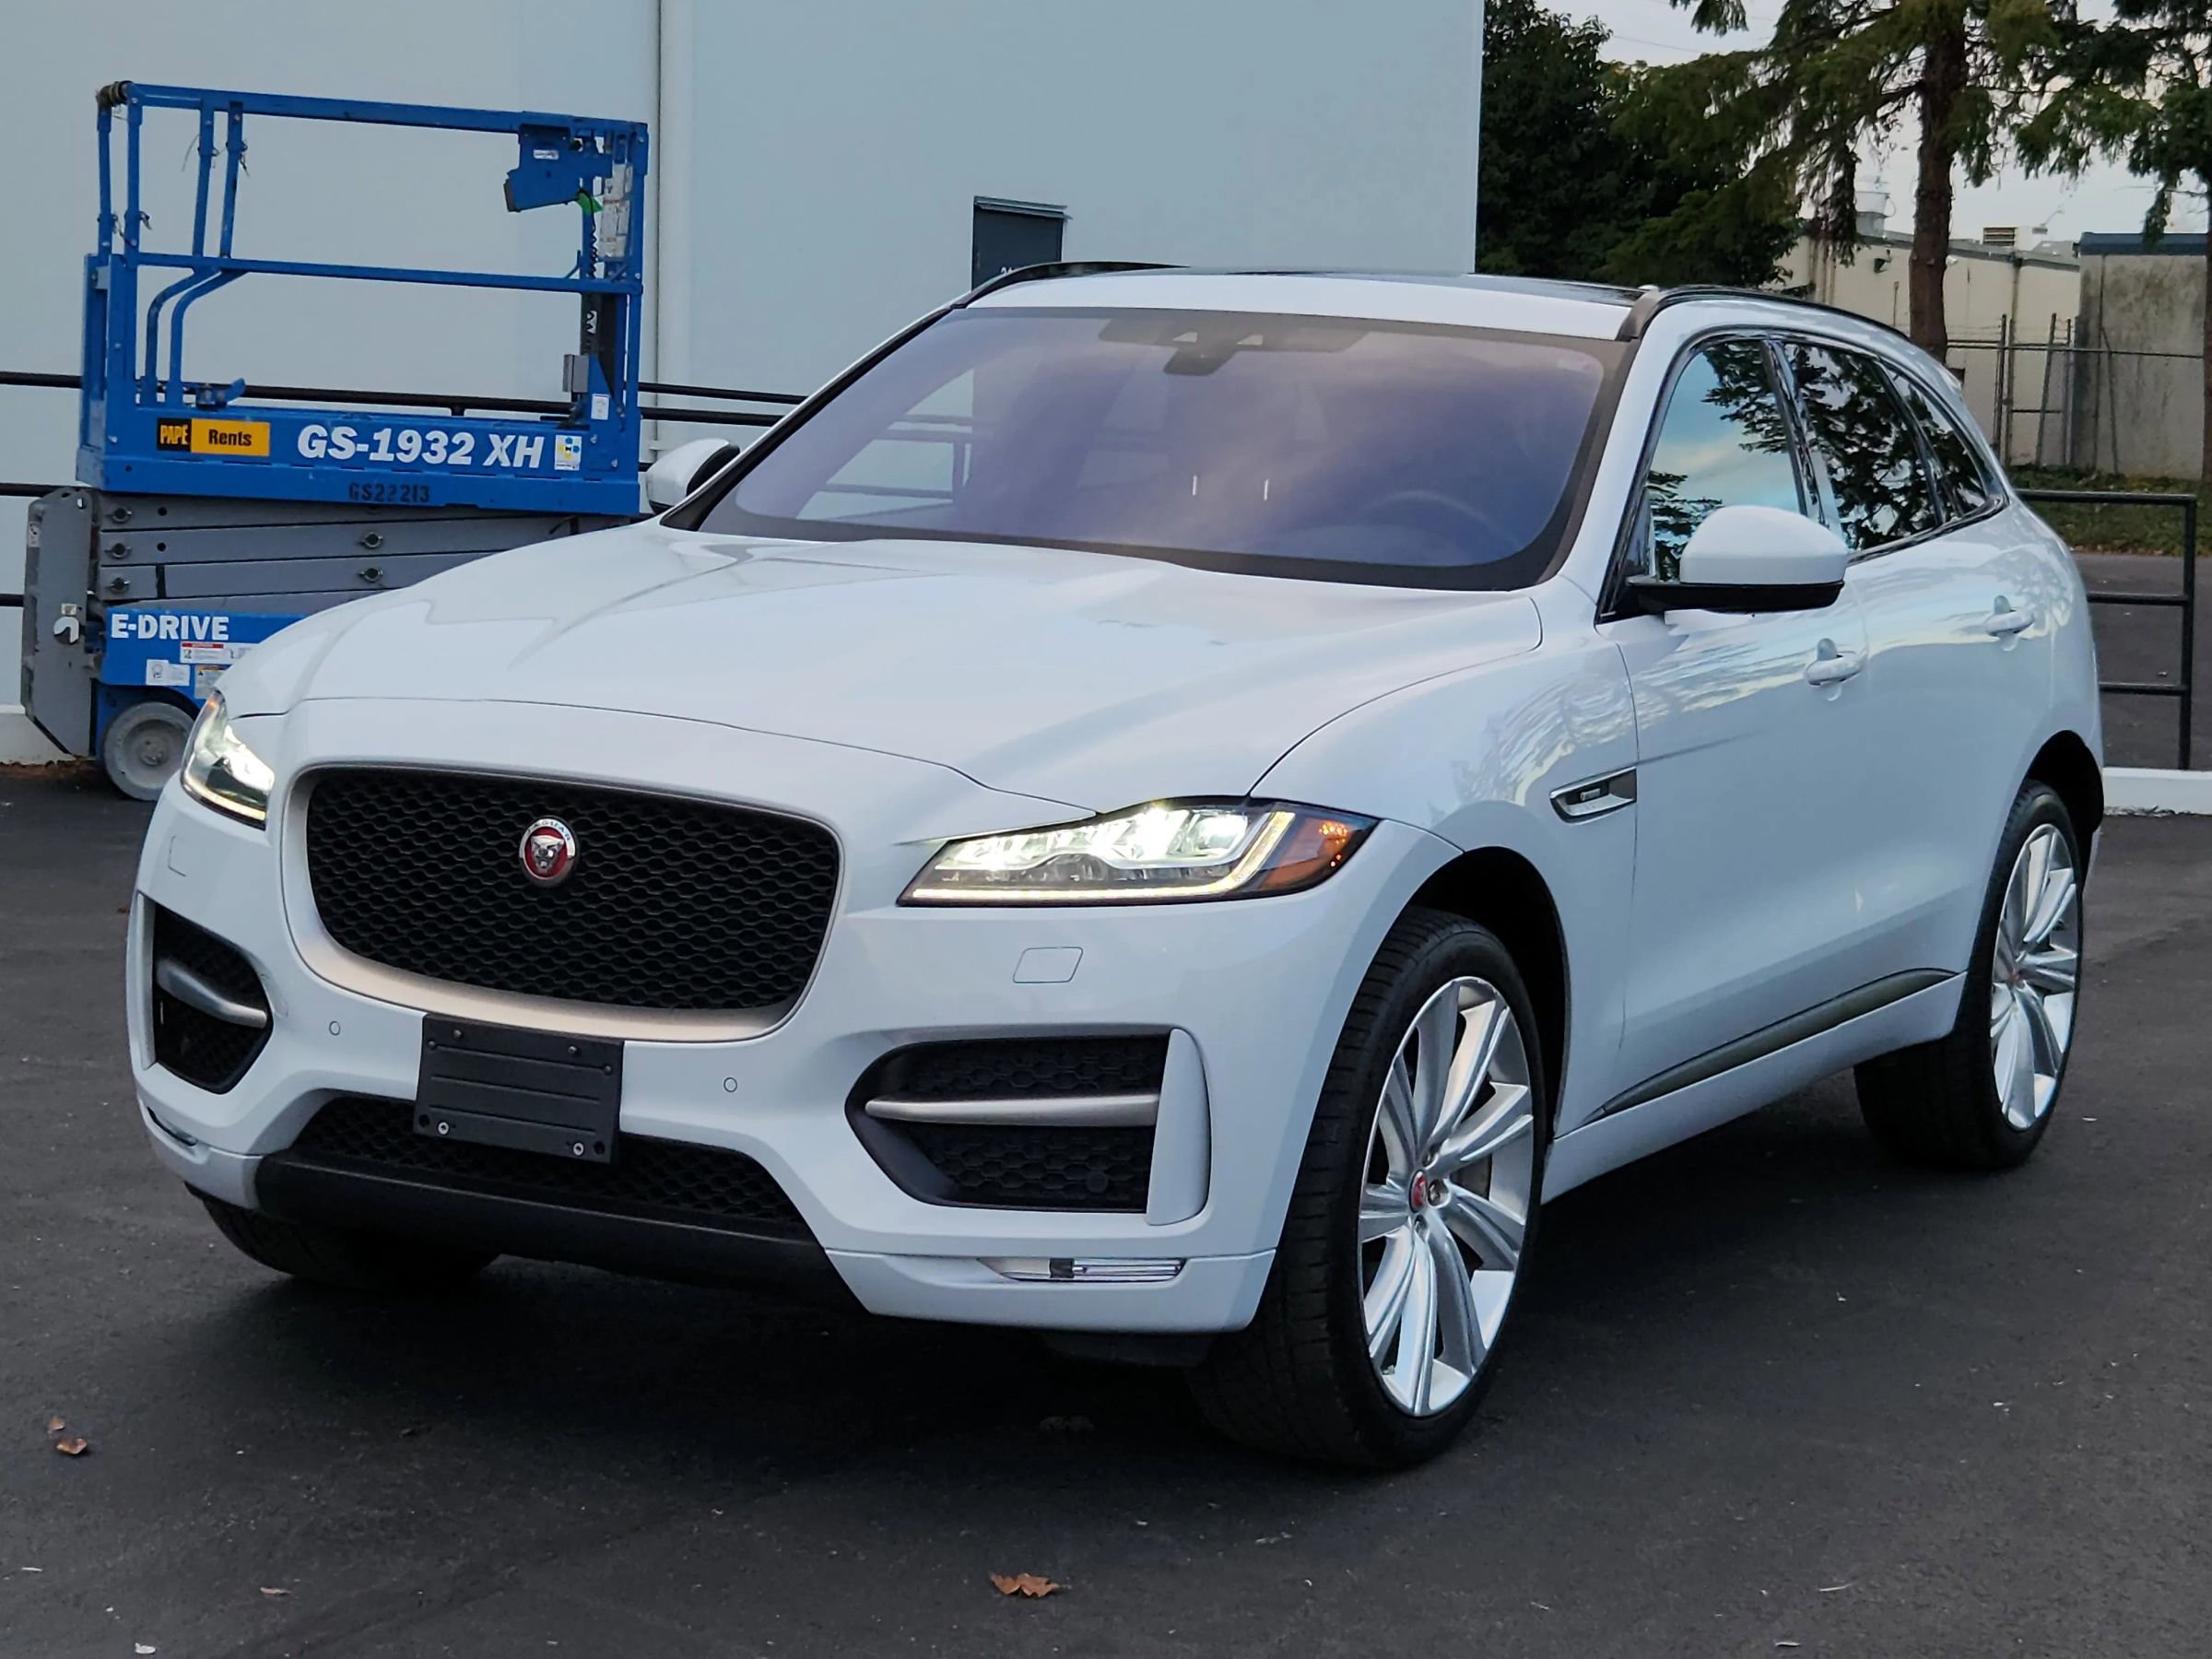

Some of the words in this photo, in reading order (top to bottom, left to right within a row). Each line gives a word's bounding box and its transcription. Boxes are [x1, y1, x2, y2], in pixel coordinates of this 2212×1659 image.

[208, 428, 253, 447] Rents
[297, 424, 476, 465] GS-1932
[482, 433, 546, 468] XH
[348, 482, 429, 502] GS22213
[111, 613, 229, 641] E-DRIVE
